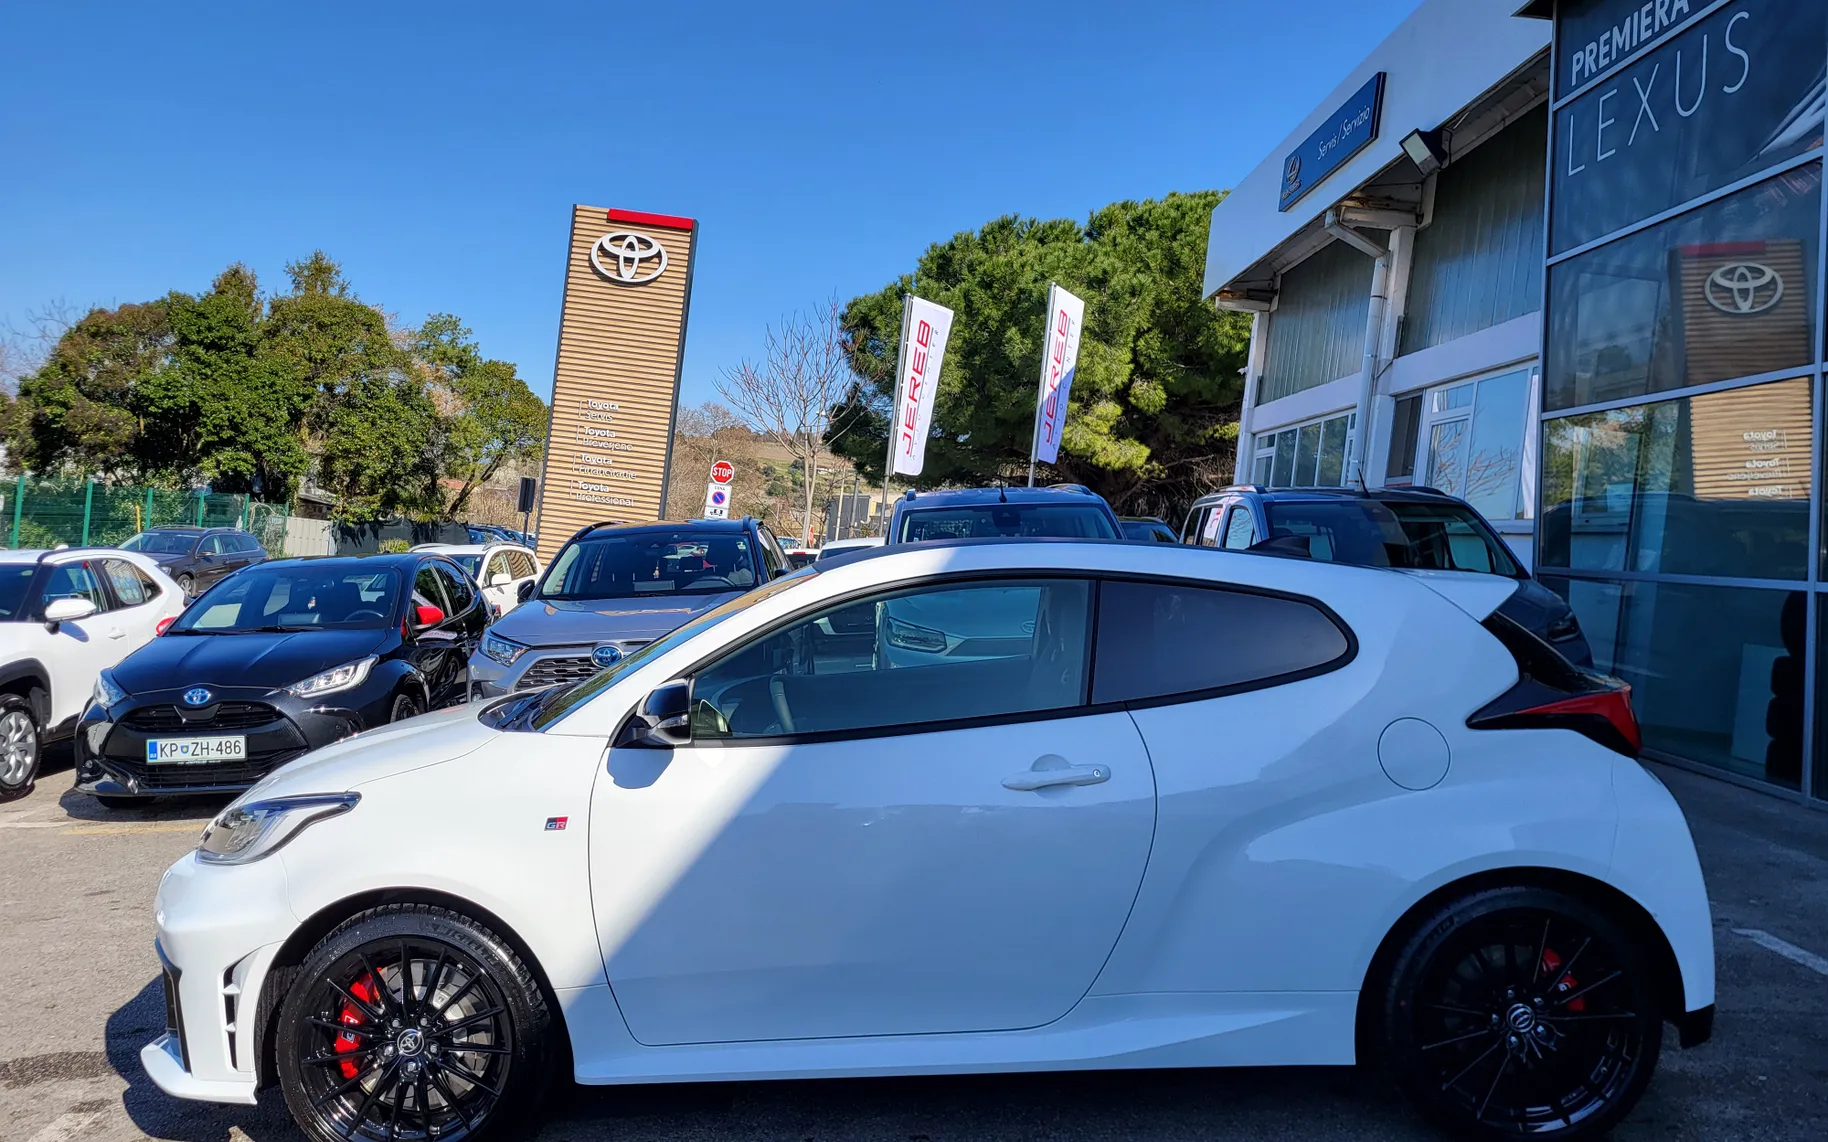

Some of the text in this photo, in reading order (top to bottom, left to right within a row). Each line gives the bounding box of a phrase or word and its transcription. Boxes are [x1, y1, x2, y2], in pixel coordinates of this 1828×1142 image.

[1572, 0, 1690, 87] PREMIERA
[1567, 11, 1750, 177] LEXUS
[1317, 132, 1337, 160] Servis
[1342, 105, 1370, 139] Servizio
[1043, 309, 1068, 444] JEREB
[902, 319, 931, 455] JEREB
[587, 399, 619, 411] Toyota
[584, 409, 613, 421] Servis
[584, 426, 616, 438] Toyota
[581, 453, 613, 465] Toyota
[712, 467, 732, 478] STOP
[577, 480, 610, 493] Toyota
[160, 740, 241, 757] KP ZH-486
[546, 821, 566, 829] GR
